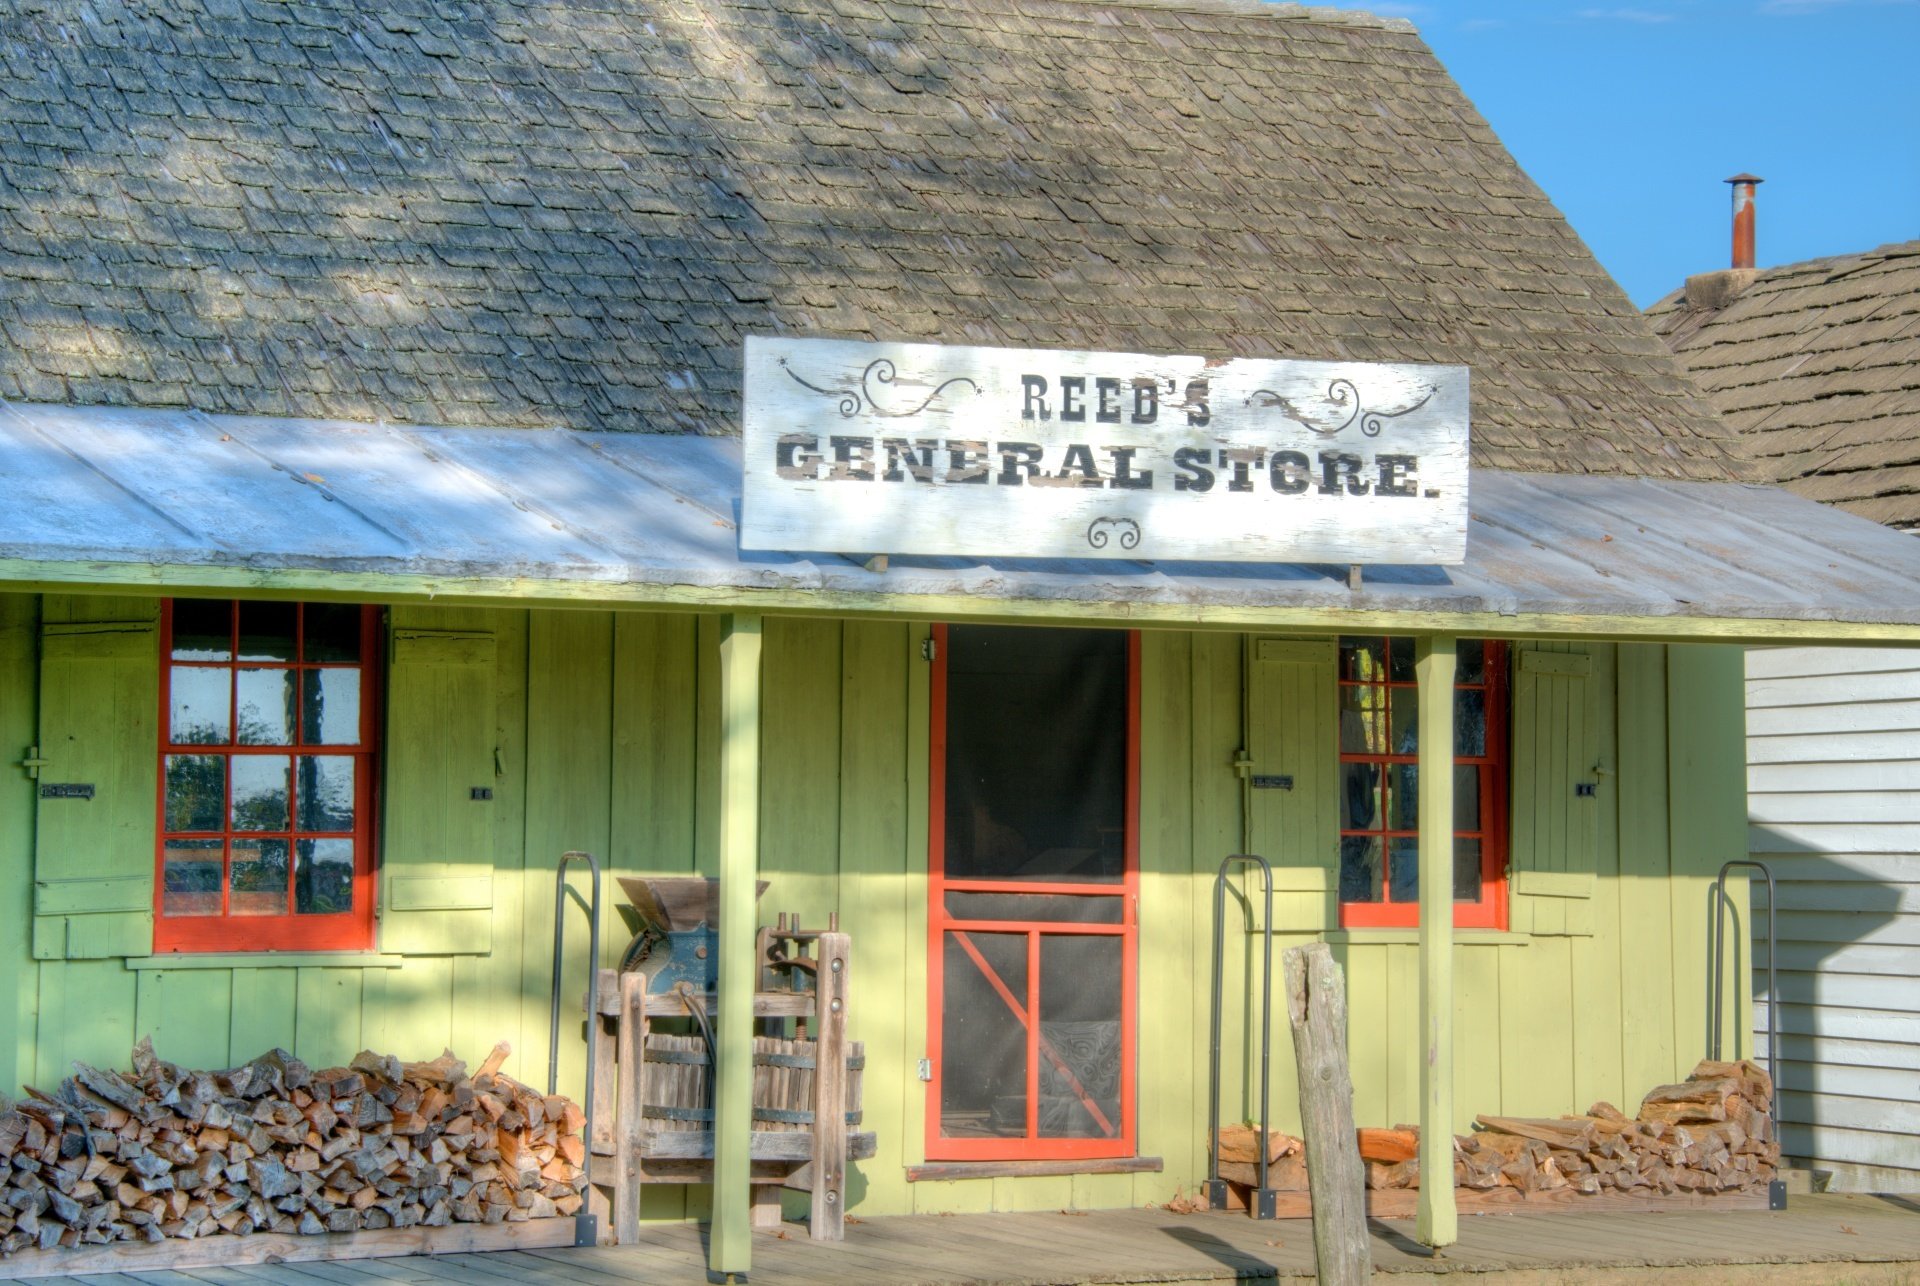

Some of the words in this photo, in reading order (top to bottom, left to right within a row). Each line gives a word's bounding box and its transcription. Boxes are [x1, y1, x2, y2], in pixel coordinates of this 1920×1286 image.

[1021, 374, 1211, 427] REED'S
[776, 433, 1154, 490] GENERAL
[1173, 447, 1441, 498] STORE.
